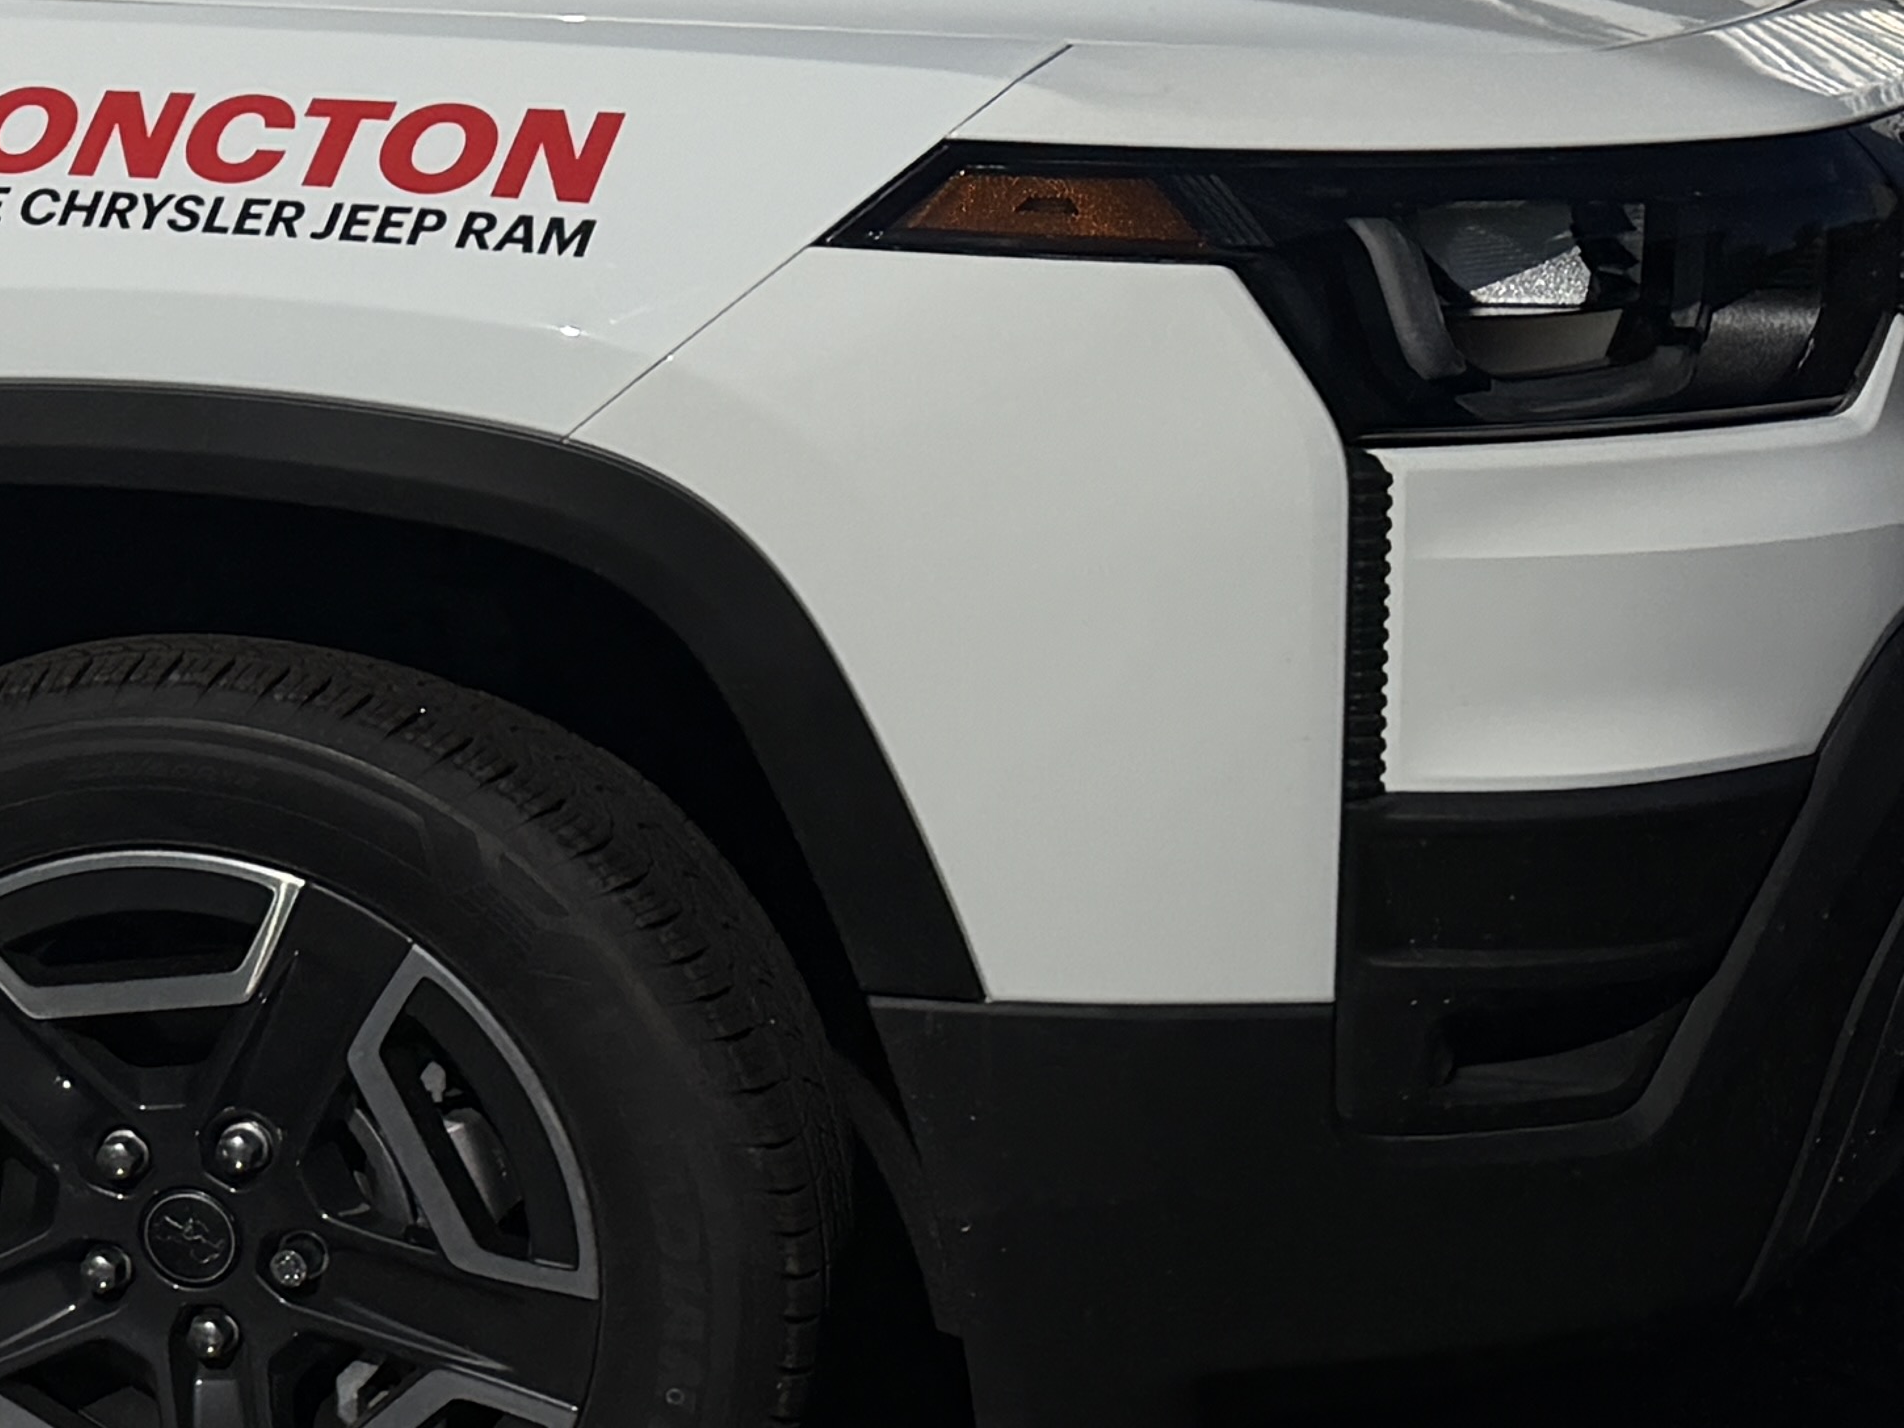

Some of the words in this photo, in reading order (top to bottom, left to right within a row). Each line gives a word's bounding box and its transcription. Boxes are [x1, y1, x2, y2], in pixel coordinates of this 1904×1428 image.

[19, 187, 305, 239] CHRYSLER
[309, 200, 448, 247] JEEP
[454, 210, 598, 259] RAM
